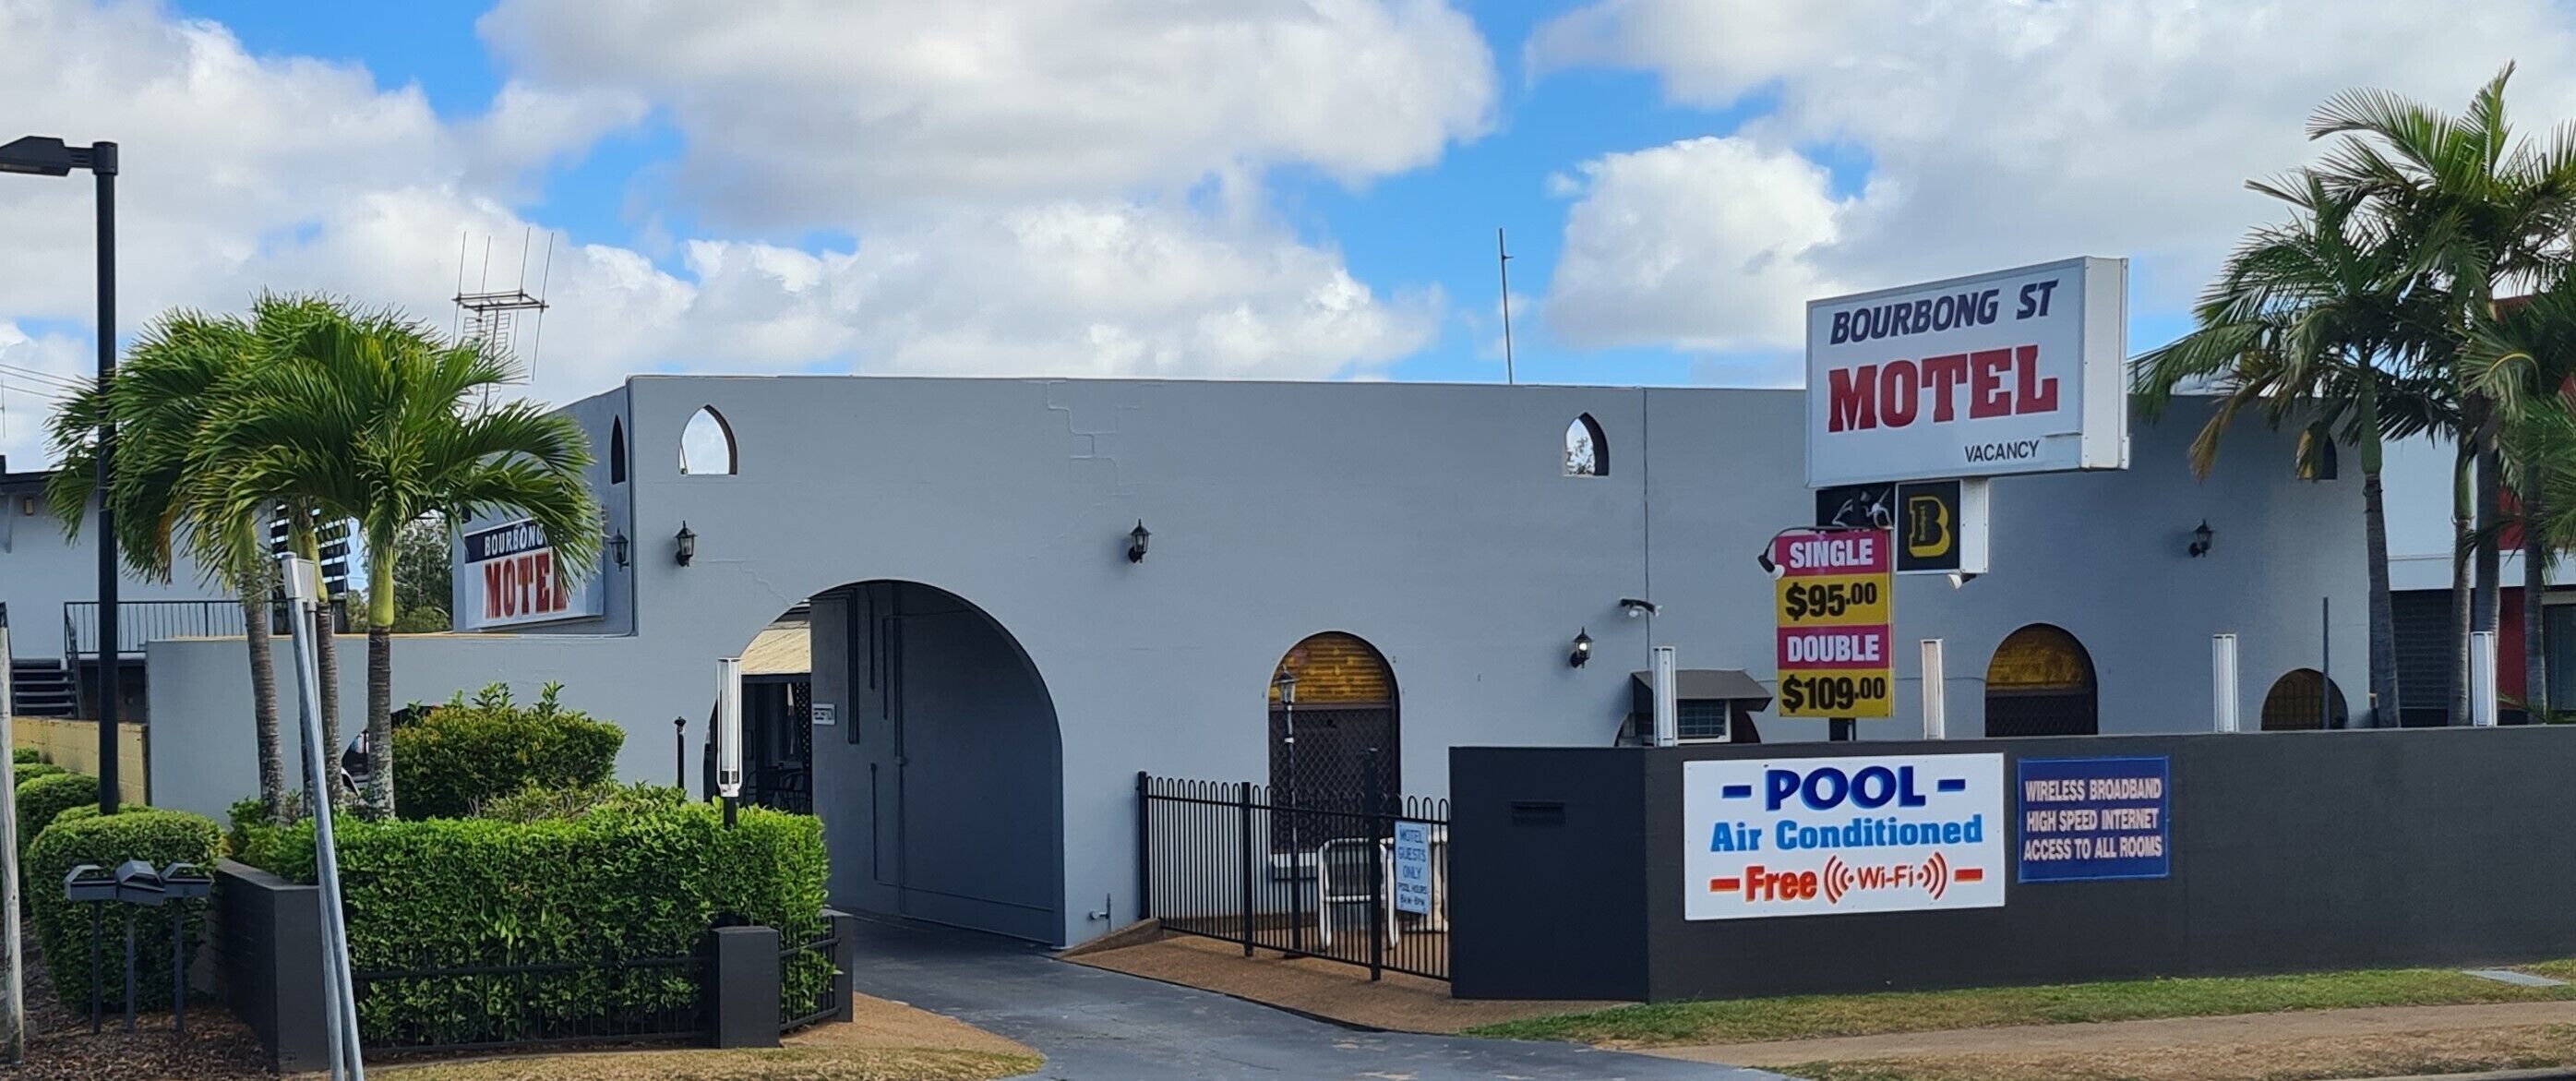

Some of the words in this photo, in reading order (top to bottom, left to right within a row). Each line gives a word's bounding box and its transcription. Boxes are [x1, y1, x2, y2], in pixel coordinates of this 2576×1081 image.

[1829, 288, 2000, 345] BOURBONG
[2016, 278, 2059, 320] ST
[1827, 344, 2058, 433] MOTEL
[1965, 438, 2040, 462] VACANCY
[1909, 496, 1950, 558] B
[1789, 538, 1875, 570] SINGLE
[1785, 582, 1877, 621] $95.00
[1787, 634, 1880, 663] DOUBLE
[1781, 674, 1886, 714] $109.00
[1765, 765, 1926, 811] POOL
[2025, 779, 2086, 802] WIRELESS
[2089, 777, 2163, 800] BROADBAND
[1399, 829, 1424, 844] MOTEL
[1709, 821, 1763, 853] Air
[1775, 813, 1983, 851] Conditioned
[2026, 809, 2057, 833] HIGH
[2059, 809, 2098, 832] SPEED
[2101, 808, 2160, 830] INTERNET
[1397, 847, 1426, 862] GUESTS
[2023, 837, 2072, 861] ACCESS
[2074, 837, 2091, 859] TO
[2094, 836, 2117, 859] ALL
[2119, 835, 2163, 858] ROOMS
[1403, 865, 1422, 880] ONLY
[1744, 865, 1817, 903] Free
[1856, 865, 1914, 890] Wi-Fi
